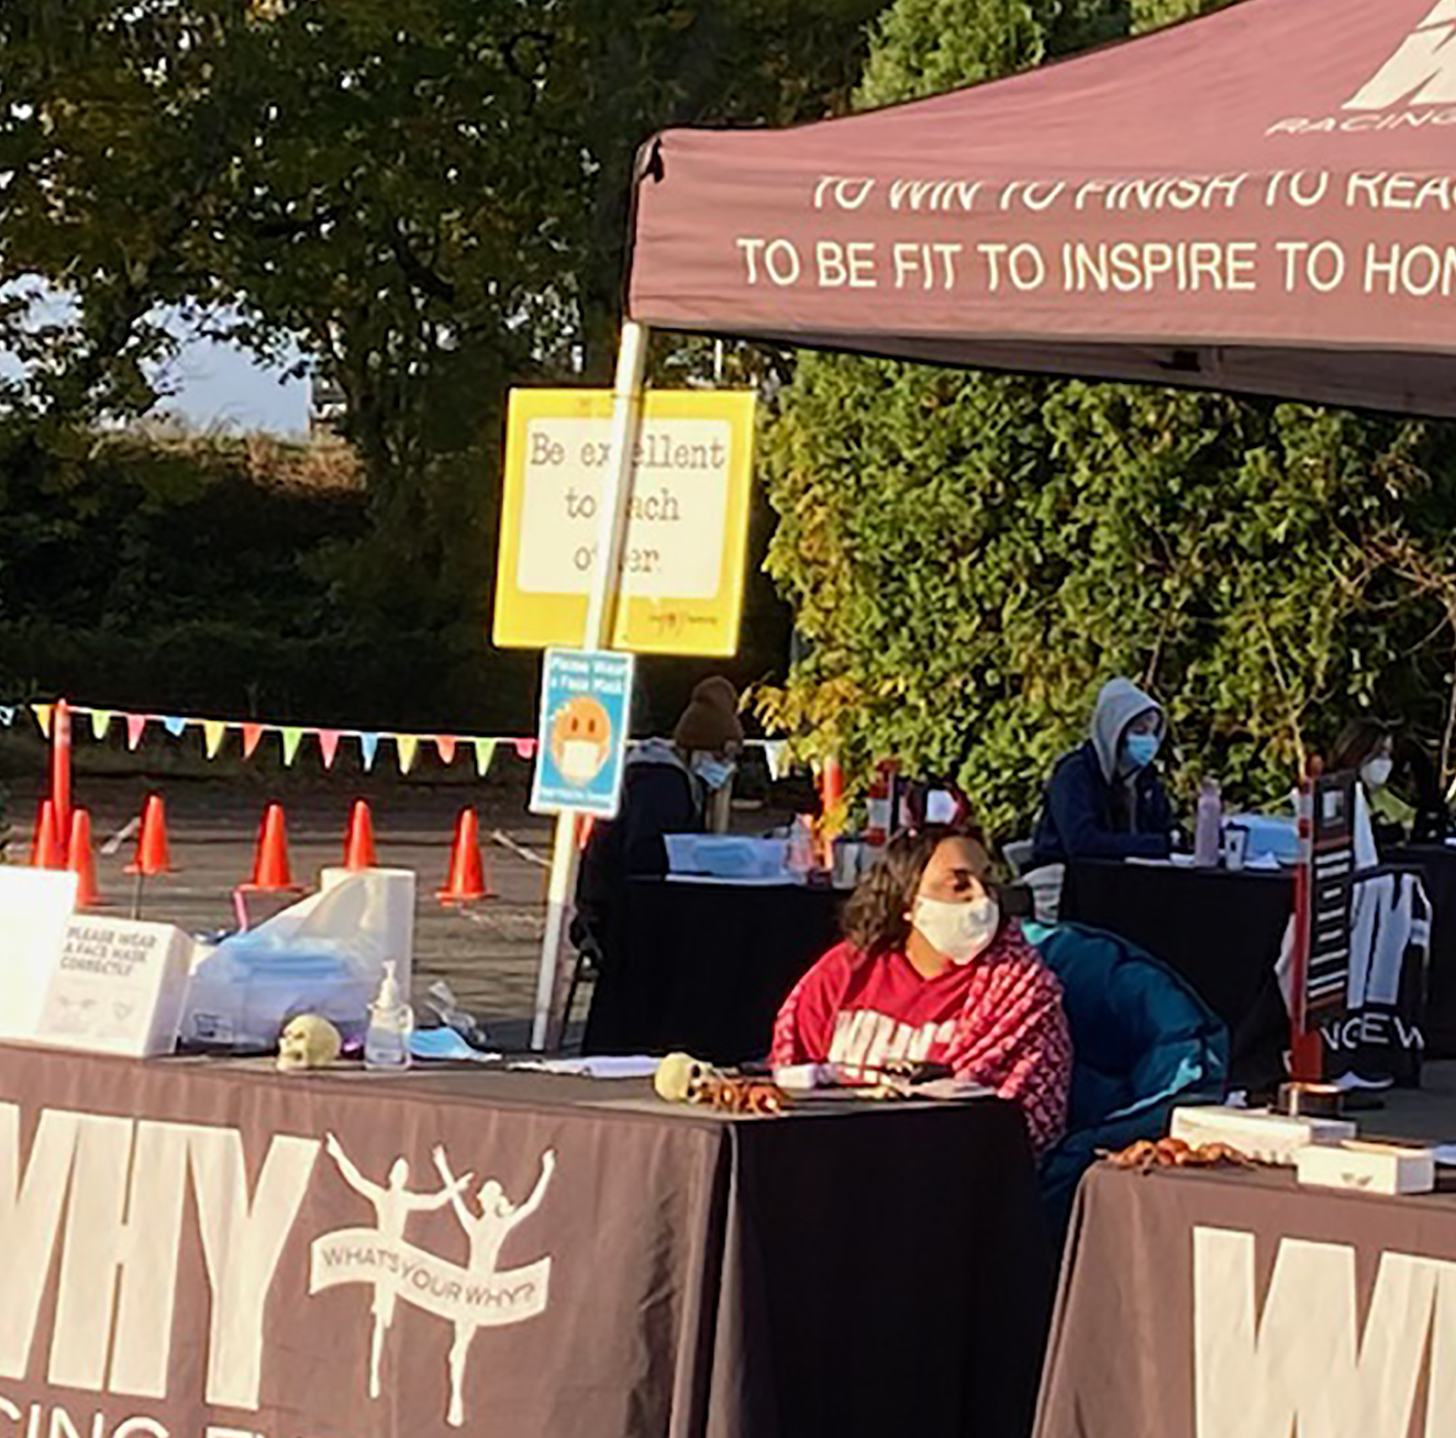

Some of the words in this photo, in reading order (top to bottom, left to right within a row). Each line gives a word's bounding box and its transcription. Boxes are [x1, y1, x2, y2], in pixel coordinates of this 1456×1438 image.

[888, 175, 978, 211] WIN
[1074, 172, 1247, 212] FINISH
[1264, 170, 1331, 208] TO
[736, 238, 800, 286] TO
[816, 240, 879, 289] BE
[893, 242, 963, 290] FIT
[976, 242, 1046, 290] TO
[1063, 242, 1257, 293] INSPIRE
[1275, 240, 1346, 292] TO
[530, 432, 566, 467] Be
[579, 434, 727, 471] exellent
[565, 487, 597, 519] to
[65, 926, 115, 944] PLEASE
[117, 931, 158, 949] WEAR
[75, 943, 108, 959] FACE
[111, 947, 148, 963] MASK
[58, 955, 134, 976] CORRECTLY
[399, 1260, 463, 1301] YOUR
[465, 1281, 537, 1307] WHY?
